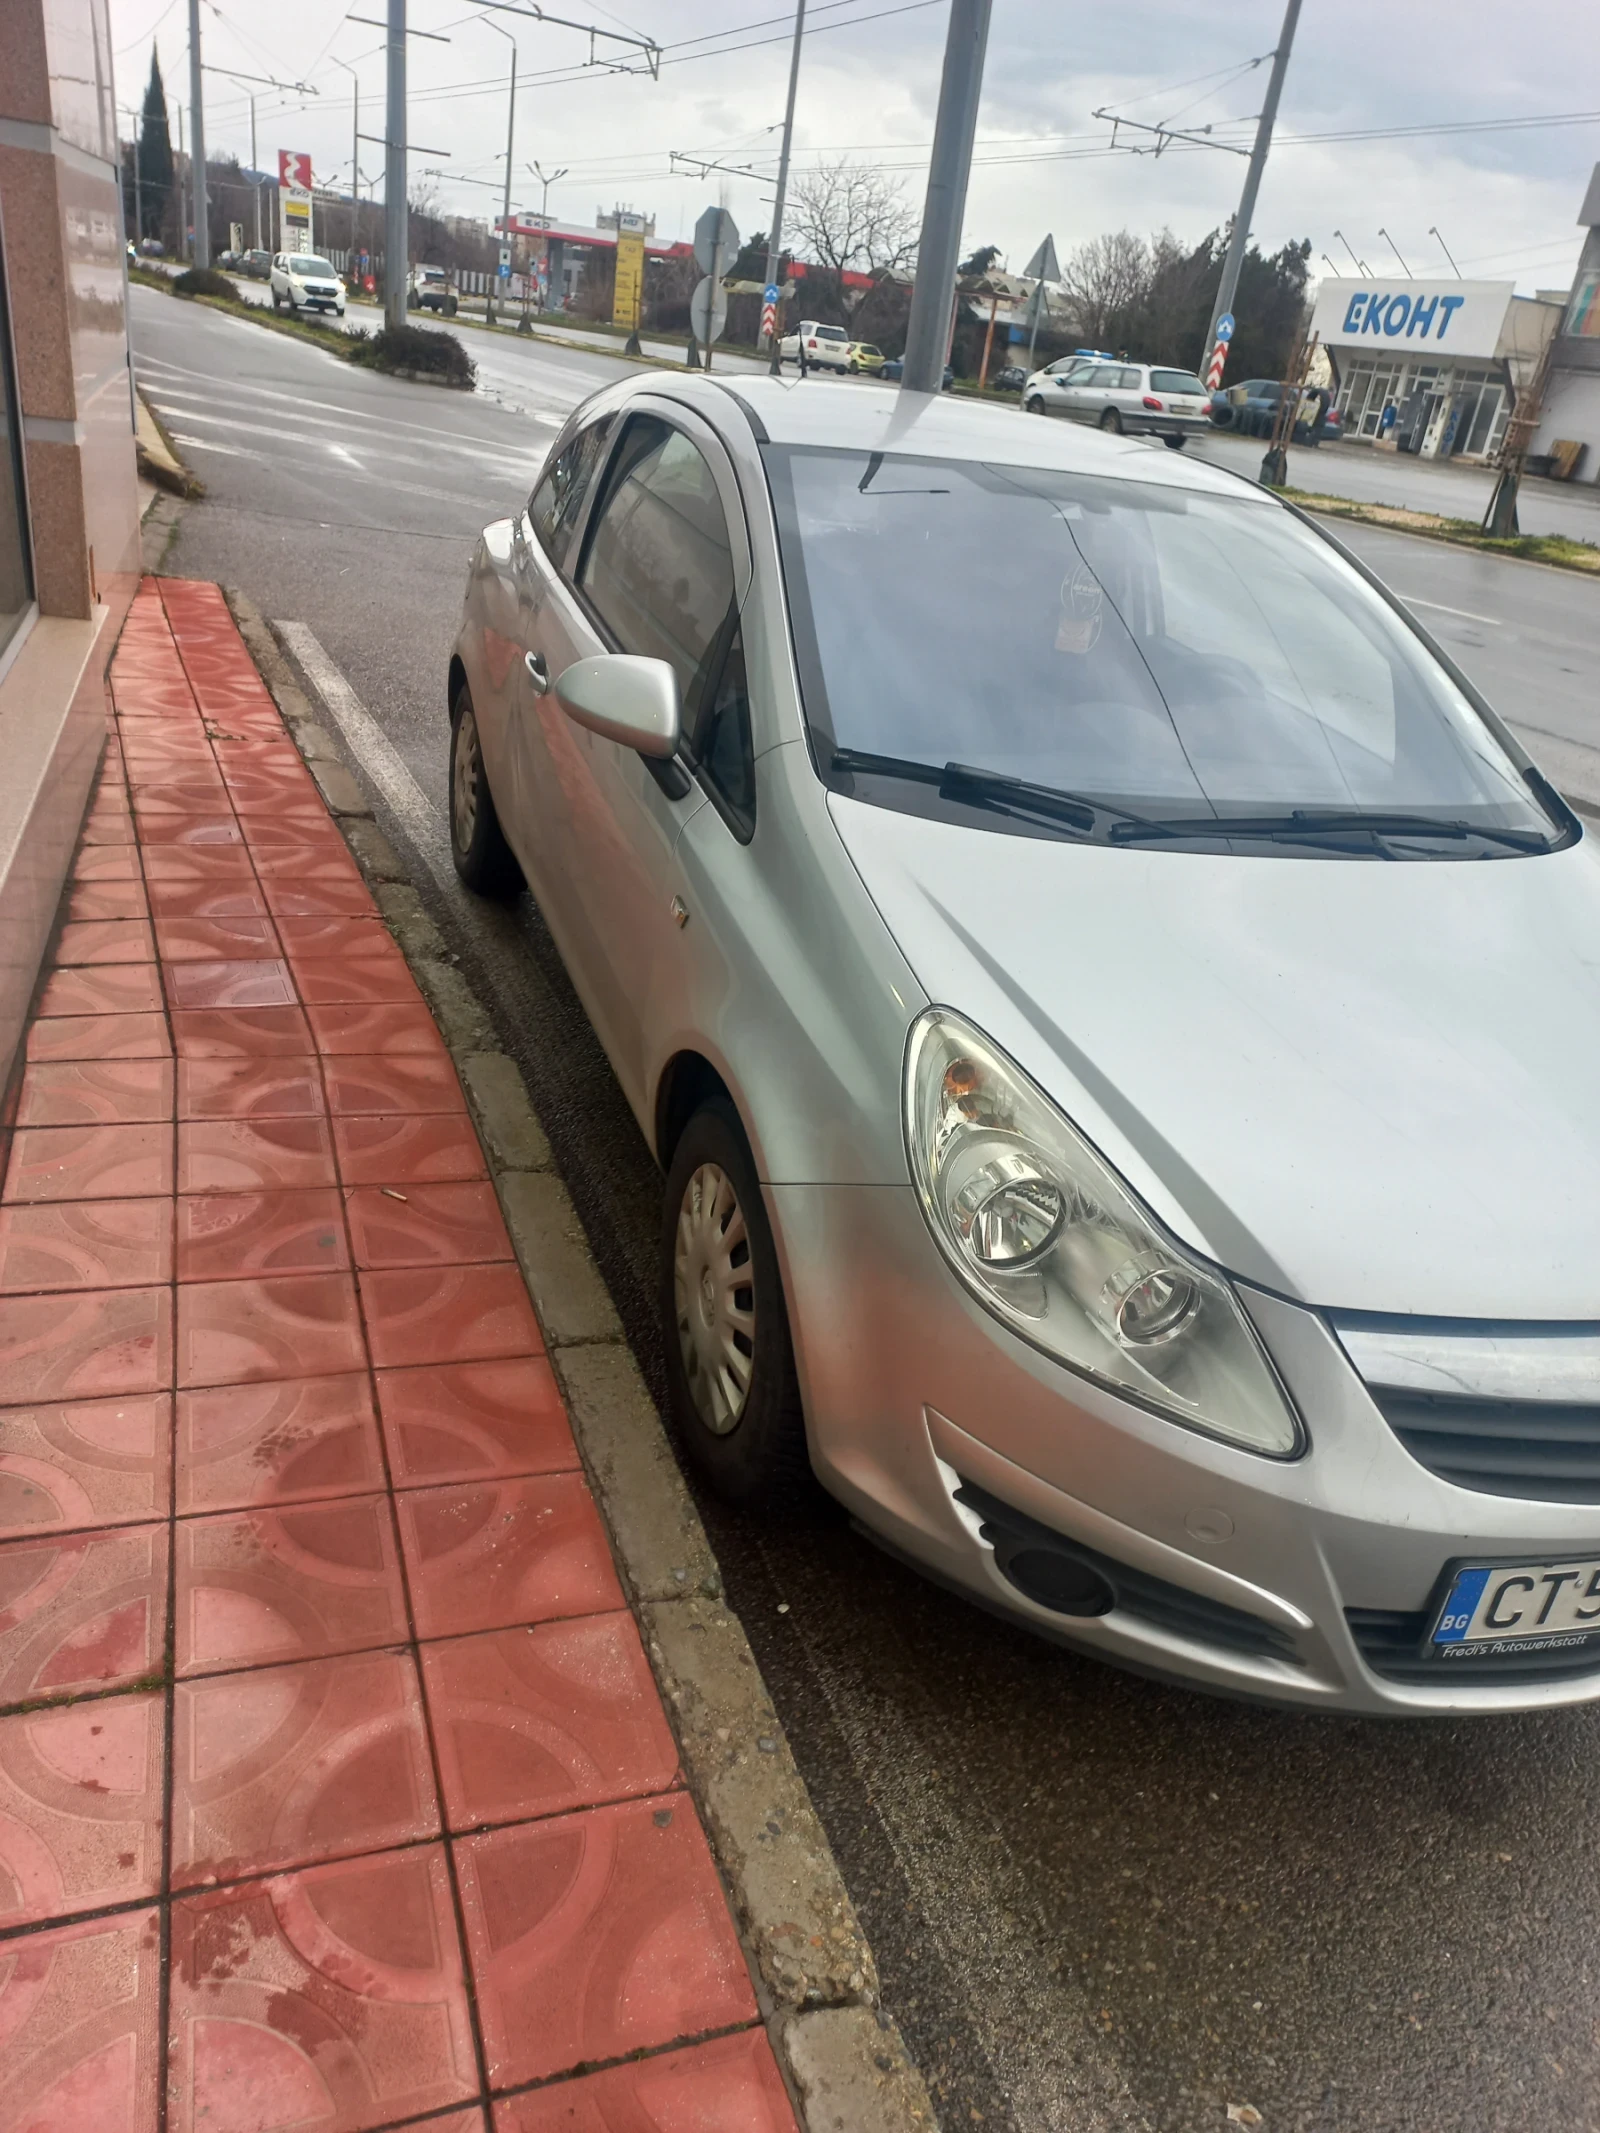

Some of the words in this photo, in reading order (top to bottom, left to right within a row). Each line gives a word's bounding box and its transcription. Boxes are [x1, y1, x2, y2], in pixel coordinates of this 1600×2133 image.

[525, 218, 550, 229] EKO
[1342, 293, 1464, 340] ЕКОНТ
[1440, 1614, 1469, 1631] BG
[1442, 1643, 1488, 1658] Fredi's
[1491, 1635, 1588, 1654] Autowerkstatt
